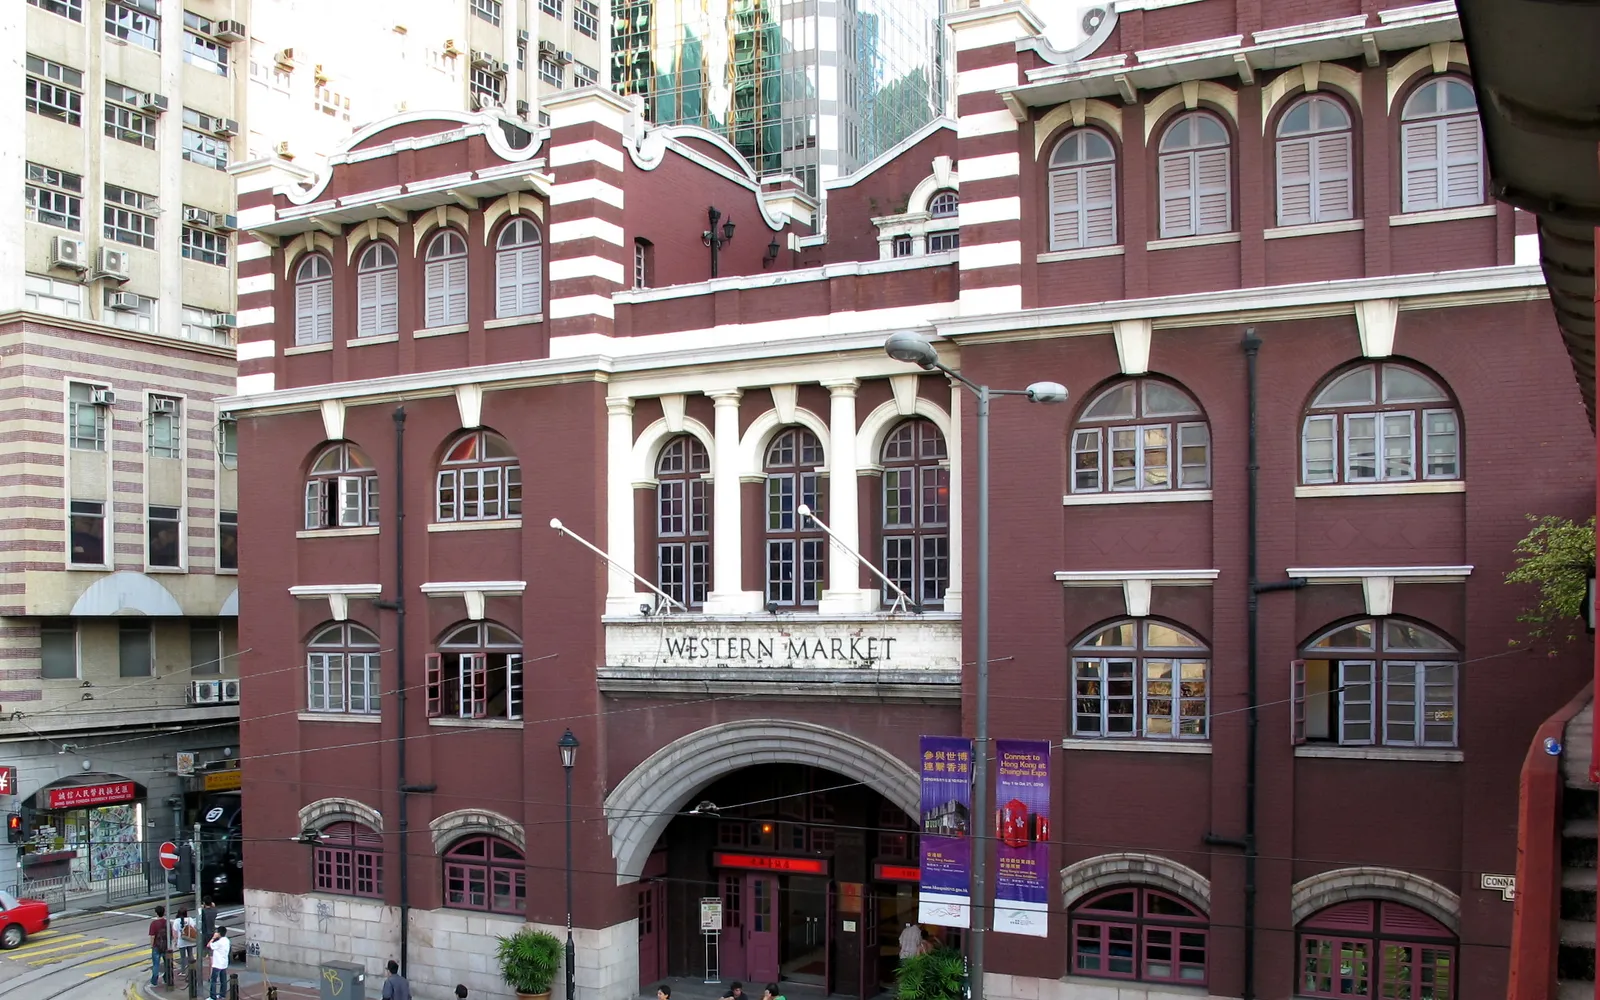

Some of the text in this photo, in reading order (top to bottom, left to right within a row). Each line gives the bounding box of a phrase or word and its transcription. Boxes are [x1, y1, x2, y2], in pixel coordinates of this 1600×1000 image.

[665, 637, 897, 661] WESTERN MARKET
[1004, 753, 1031, 761] Connect
[1000, 760, 1019, 769] Hong
[1019, 761, 1037, 770] Kong
[999, 768, 1048, 778] Shanghai Expo
[1486, 877, 1514, 887] CONNA
